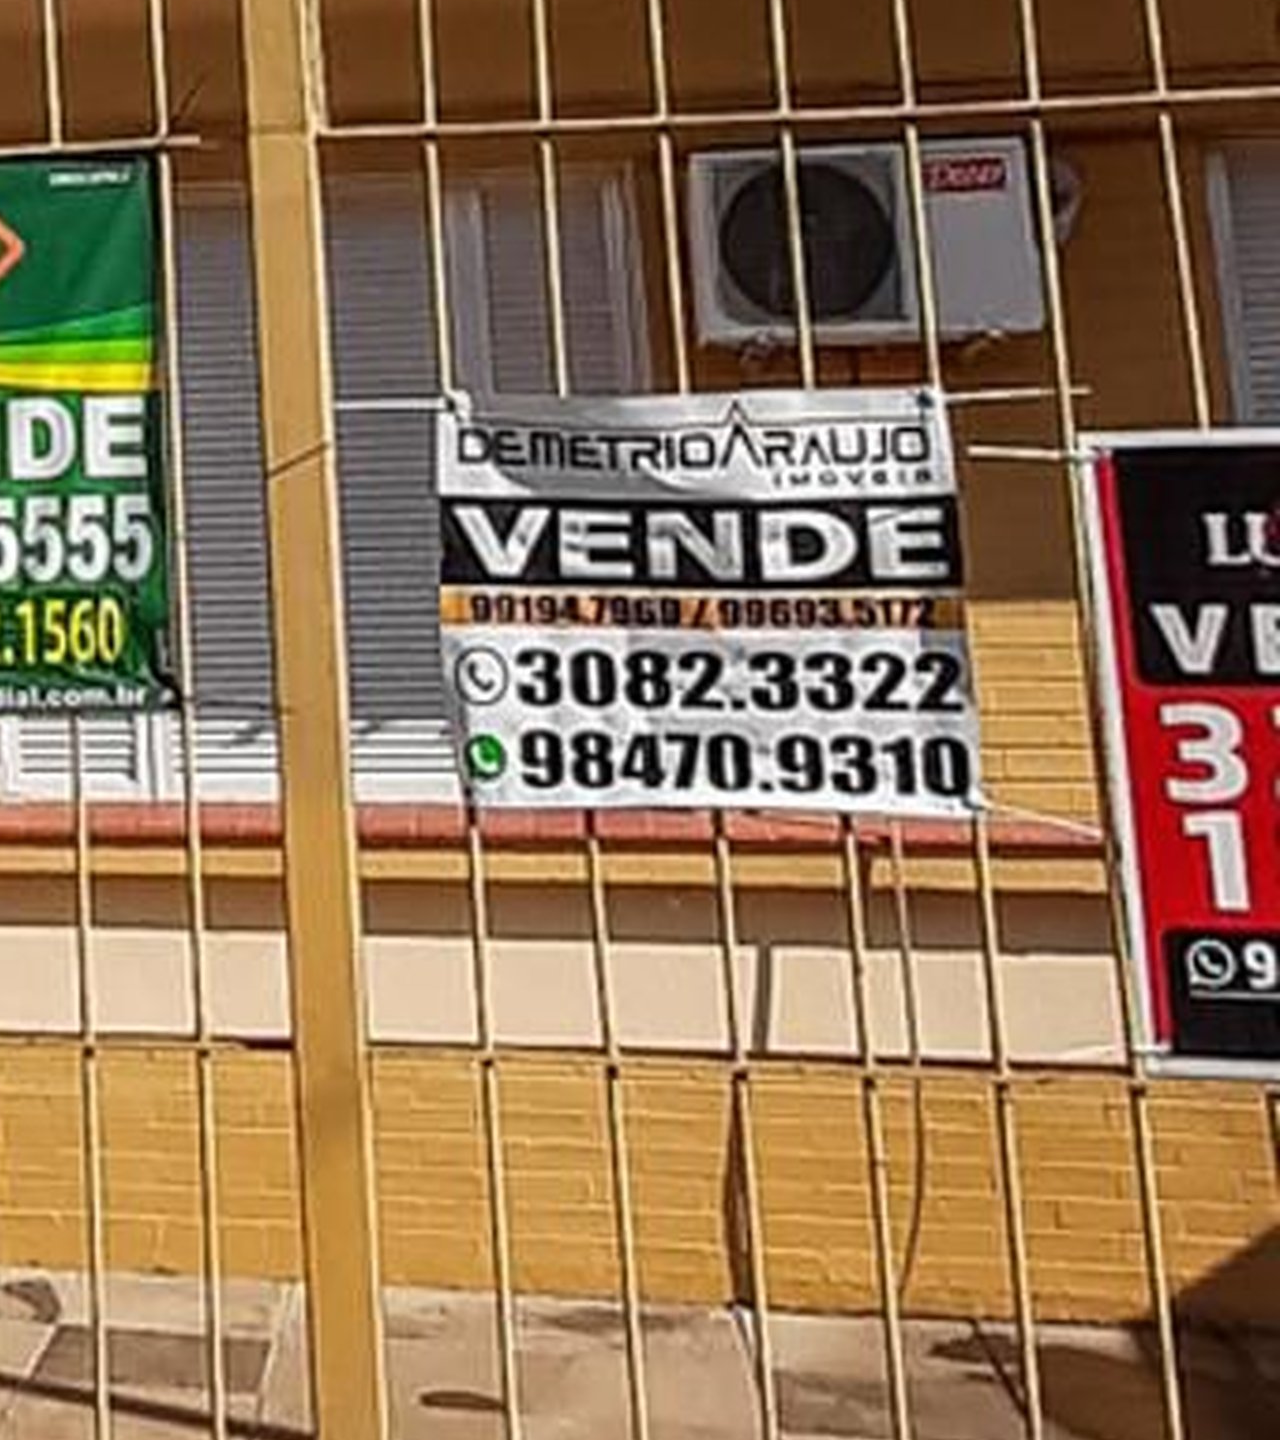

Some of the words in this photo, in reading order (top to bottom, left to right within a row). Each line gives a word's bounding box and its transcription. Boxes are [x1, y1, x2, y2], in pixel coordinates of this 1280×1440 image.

[452, 505, 950, 582] VENDE
[514, 647, 965, 715] 3082.3322
[518, 729, 971, 797] 98470.9310
[1159, 703, 1280, 803] 3
